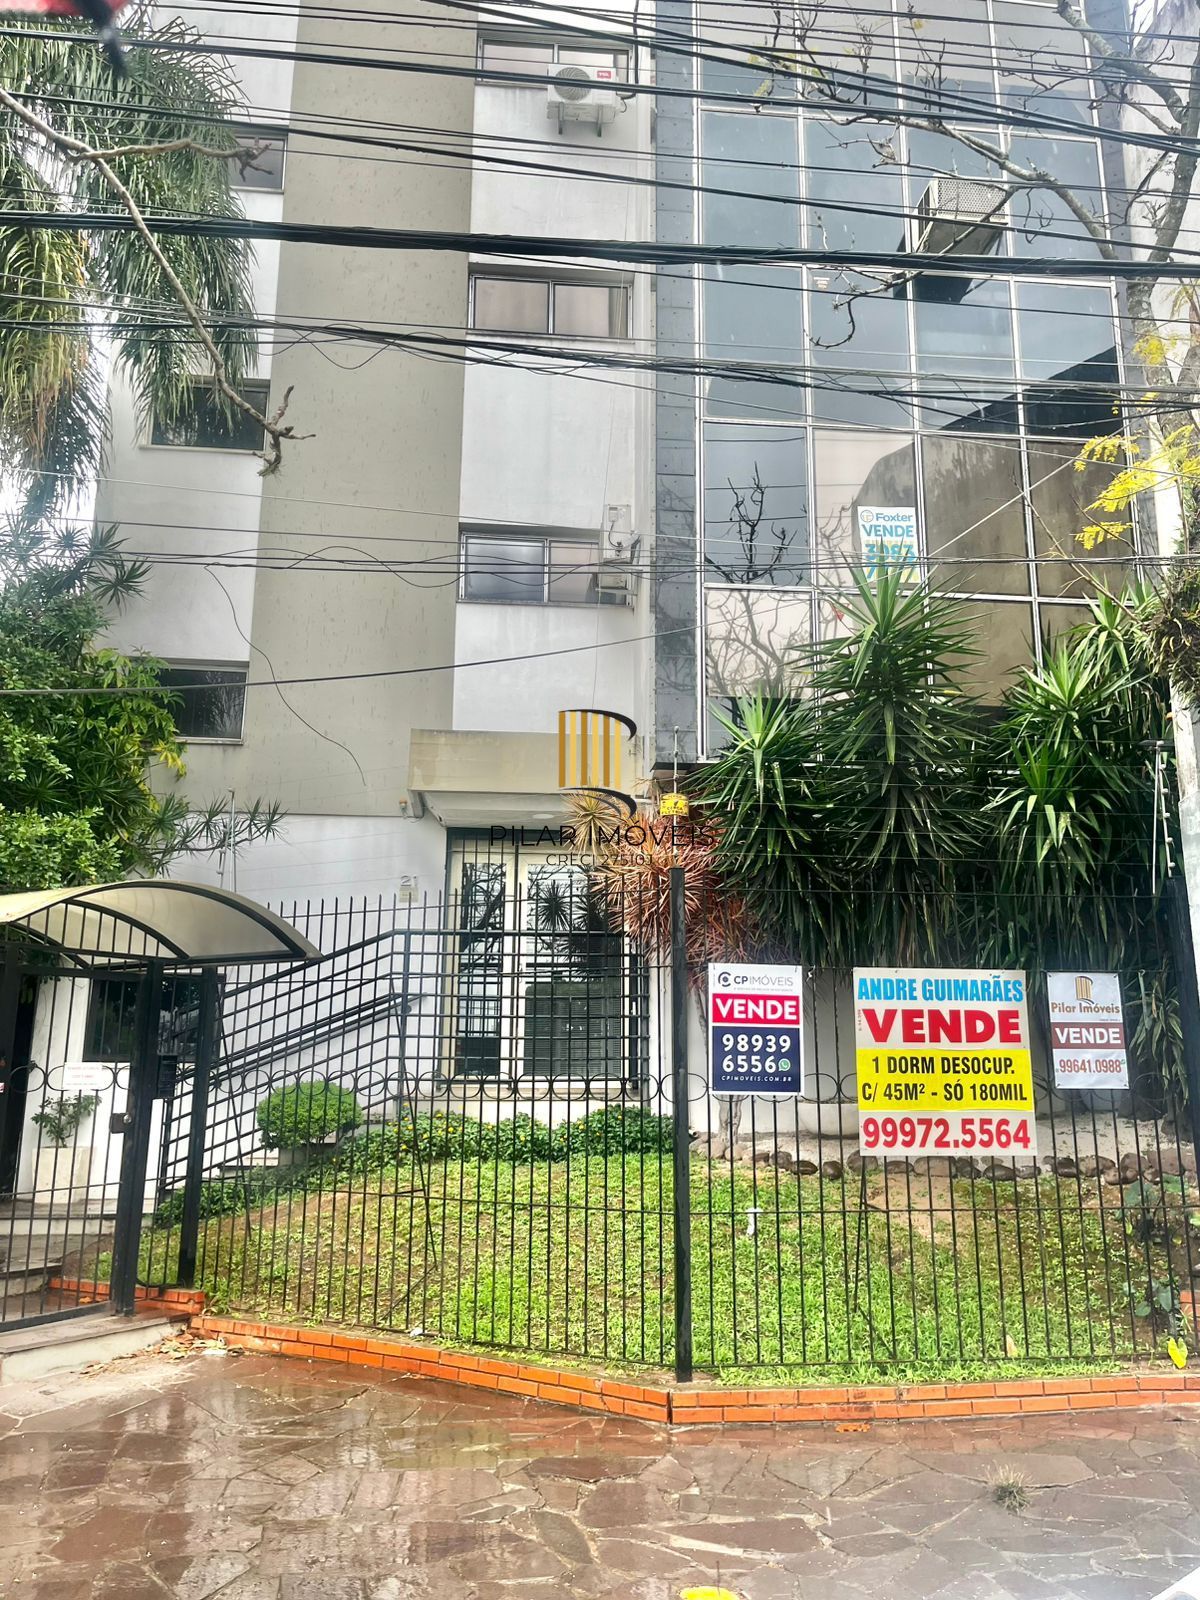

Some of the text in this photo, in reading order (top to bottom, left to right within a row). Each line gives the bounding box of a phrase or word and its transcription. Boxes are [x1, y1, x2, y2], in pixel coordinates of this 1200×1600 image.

[875, 512, 914, 522] Foxter
[861, 523, 915, 538] VENDE
[857, 974, 1024, 1003] ANDRE GUIMARÃES
[715, 997, 798, 1021] VENDE
[1051, 1001, 1121, 1014] Pilar Imóveis
[862, 1008, 1022, 1043] VENDE
[722, 1033, 791, 1053] 98939
[1055, 1027, 1122, 1044] VENDE
[722, 1054, 777, 1073] 6556
[872, 1056, 1015, 1075] 1 DORM DESOCUP.
[1059, 1059, 1122, 1074] 99641.0988
[861, 1082, 878, 1102] C/
[943, 1079, 964, 1101] SÓ
[970, 1083, 1027, 1101] 180MIL
[862, 1117, 1031, 1149] 99972.5564
